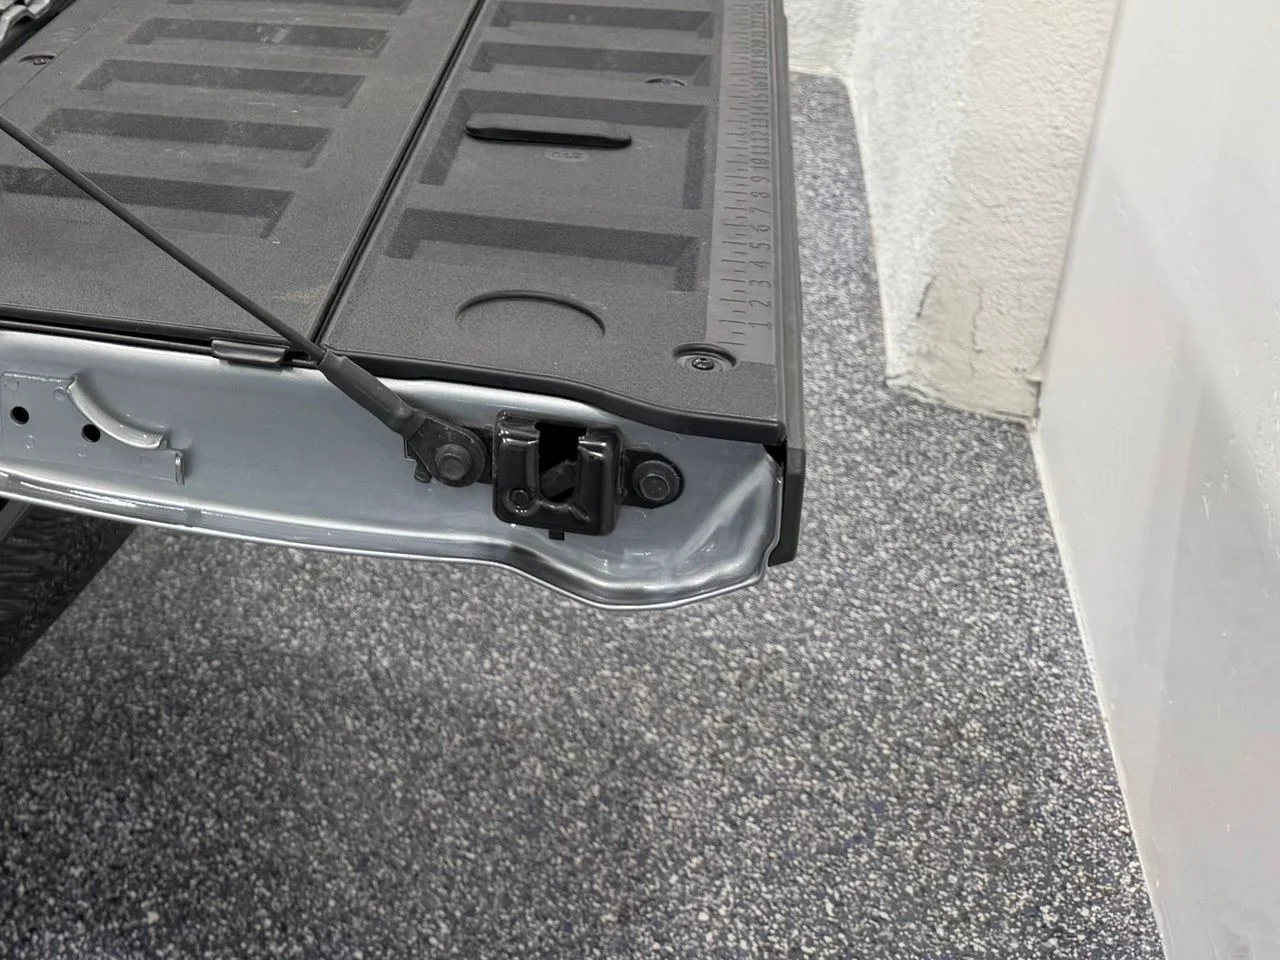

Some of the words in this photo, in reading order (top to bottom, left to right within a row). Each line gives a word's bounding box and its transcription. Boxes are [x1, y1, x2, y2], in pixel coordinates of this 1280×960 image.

[750, 93, 768, 103] 15
[750, 105, 769, 116] 14
[750, 118, 769, 129] 13
[750, 130, 769, 142] 12
[750, 145, 770, 155] 11
[750, 158, 770, 169] 10
[750, 175, 770, 183] 9
[750, 191, 770, 199] 8
[749, 206, 770, 214] 7
[749, 224, 771, 232] 6
[748, 242, 771, 250] 5
[748, 260, 771, 268] 4
[748, 280, 772, 288] 3
[748, 299, 772, 309] 2
[748, 322, 772, 330] 1
